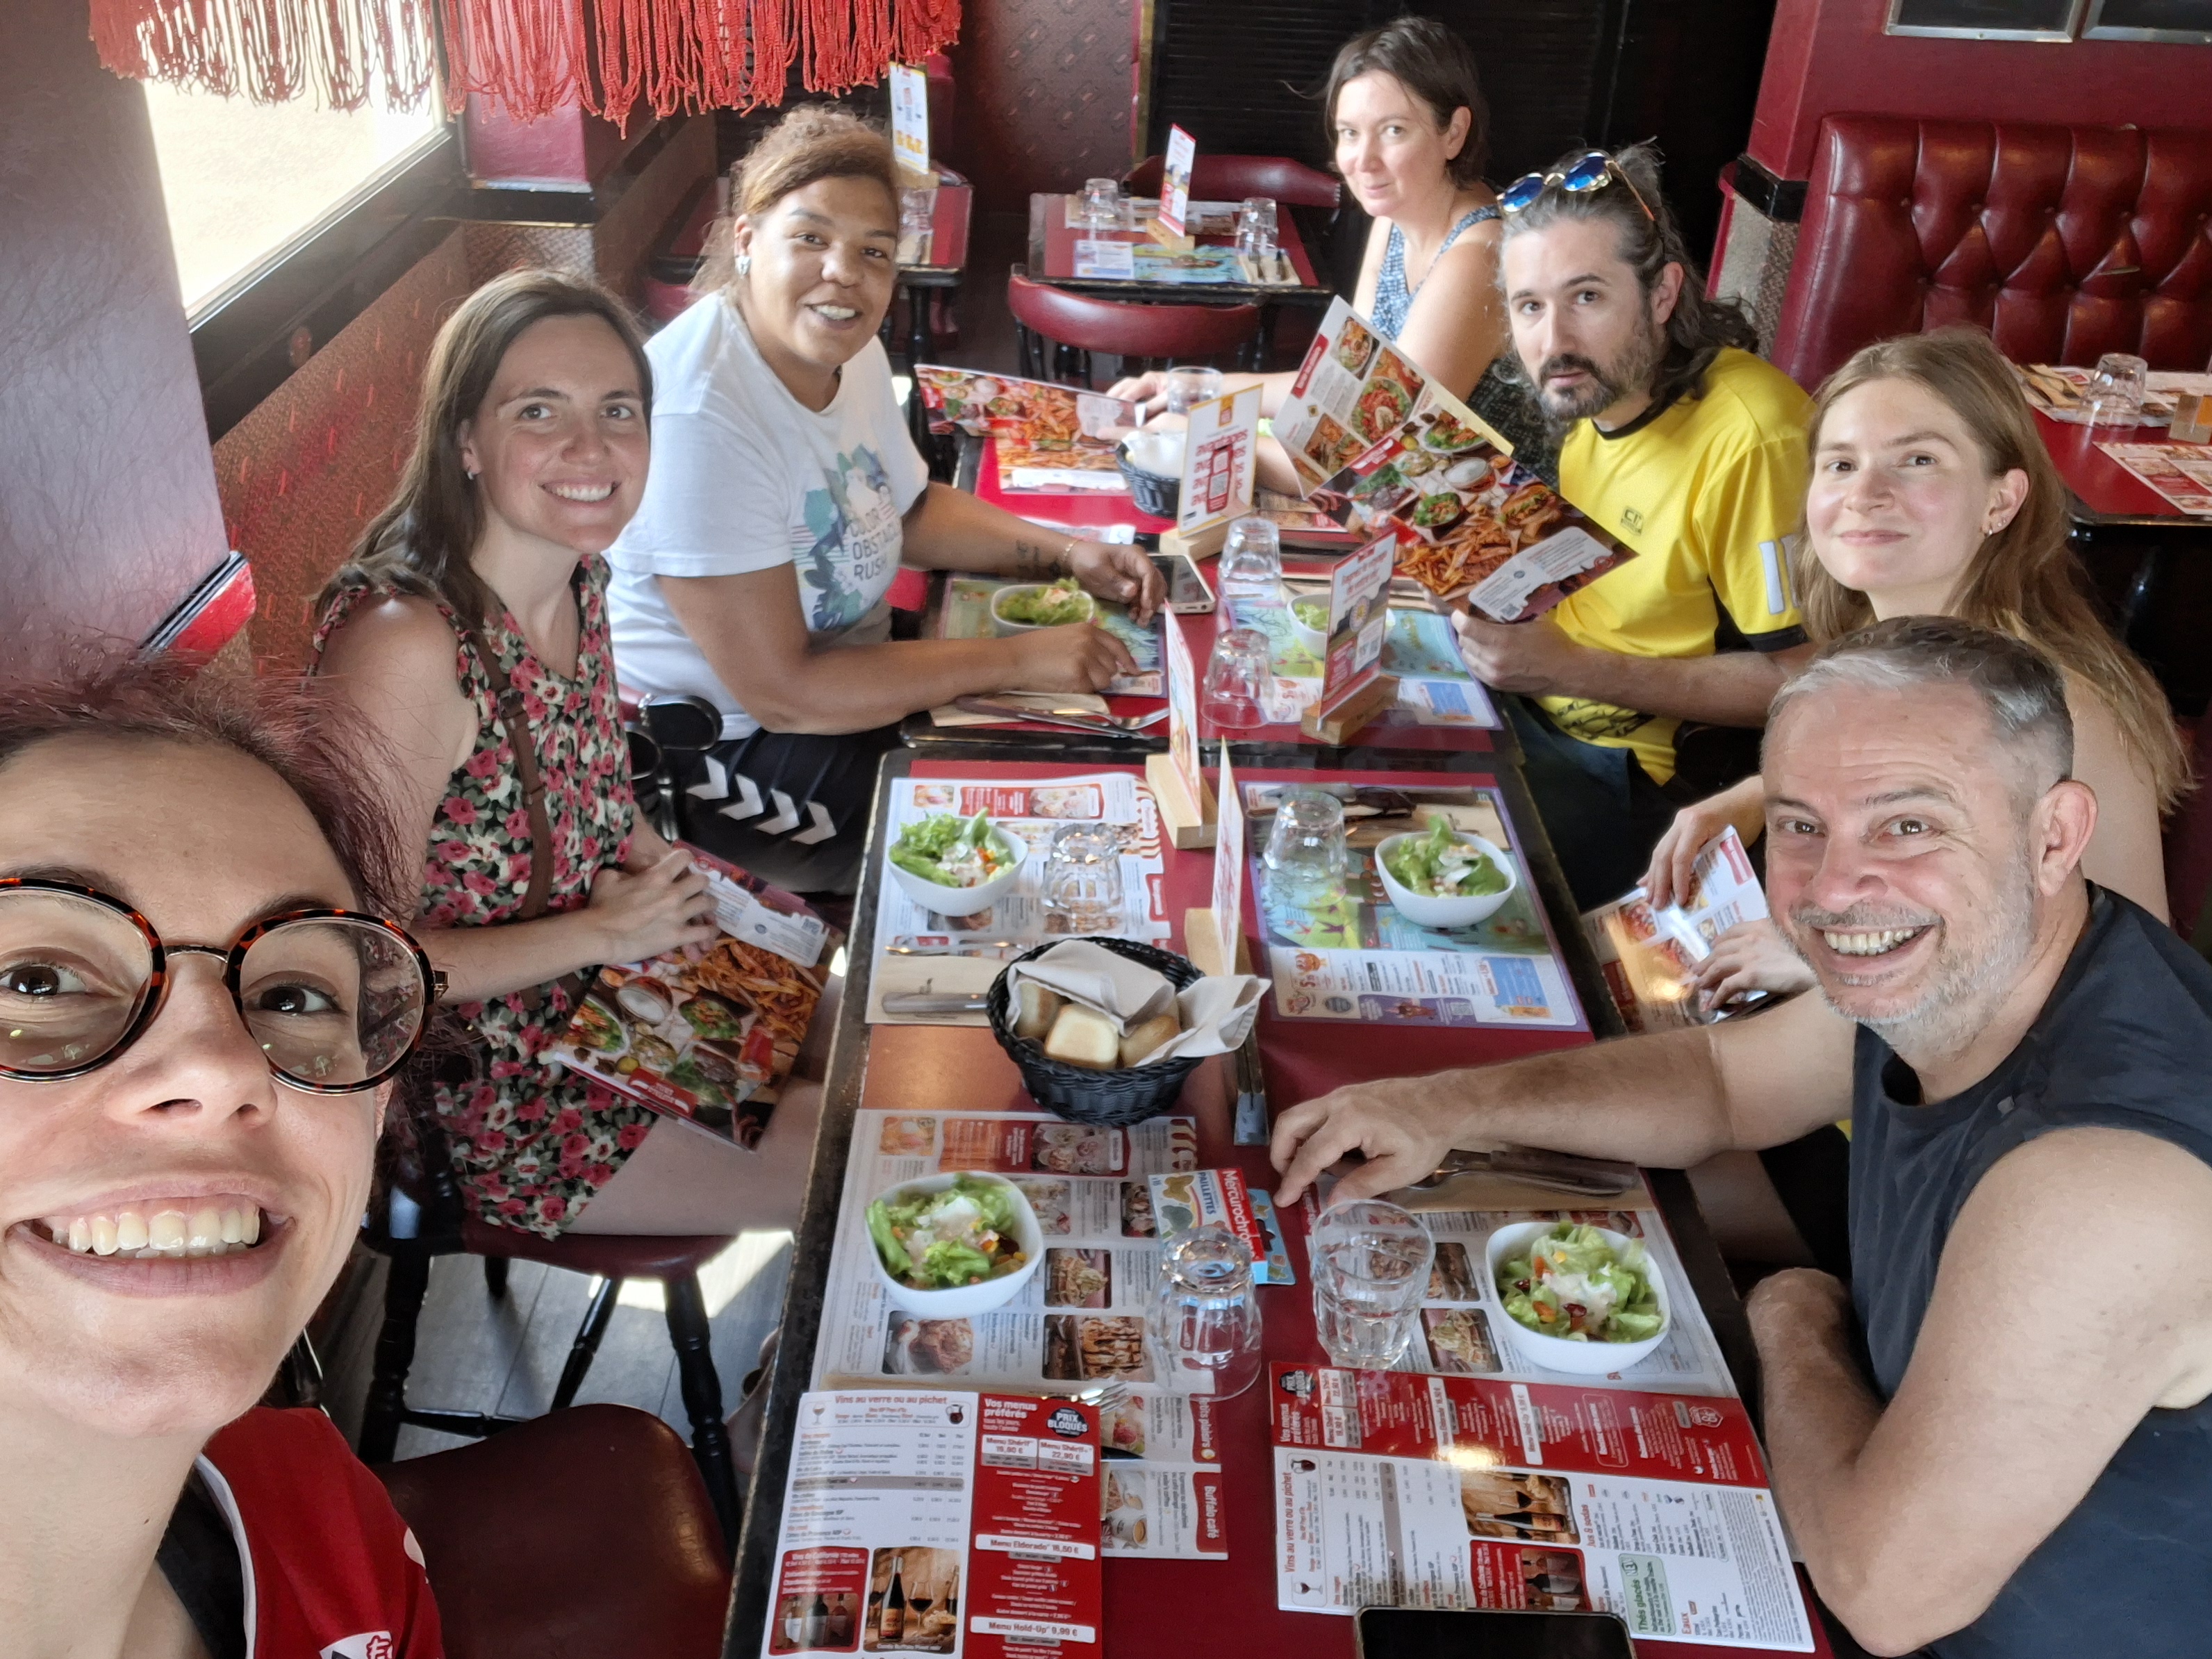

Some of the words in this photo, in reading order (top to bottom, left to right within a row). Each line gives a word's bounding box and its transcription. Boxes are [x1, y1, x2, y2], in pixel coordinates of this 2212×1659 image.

[1198, 1172, 1216, 1214] PAILLETTES
[918, 1396, 948, 1404] pichet
[984, 1398, 1002, 1408] Vos
[1004, 1401, 1038, 1411] menus
[984, 1408, 1027, 1419] préférés
[1056, 1412, 1079, 1421] PRIX
[1047, 1419, 1088, 1433] BLOQUÉS
[1198, 1419, 1212, 1448] plaisirs
[986, 1437, 1006, 1445] Menu
[1282, 1471, 1294, 1496] pichet
[1205, 1485, 1217, 1517] Buffalo
[1284, 1497, 1292, 1506] au
[1284, 1508, 1293, 1517] ou
[1580, 1503, 1592, 1526] sodas
[1206, 1518, 1219, 1538] café
[1285, 1519, 1294, 1540] verre
[1286, 1543, 1294, 1552] au
[1586, 1535, 1596, 1546] Jus
[1285, 1555, 1295, 1571] Vins
[1621, 1558, 1638, 1576] NEW
[1633, 1579, 1646, 1607] glacés
[989, 1621, 1012, 1631] Menu
[1637, 1609, 1648, 1631] Thés
[1681, 1612, 1692, 1633] Eaux
